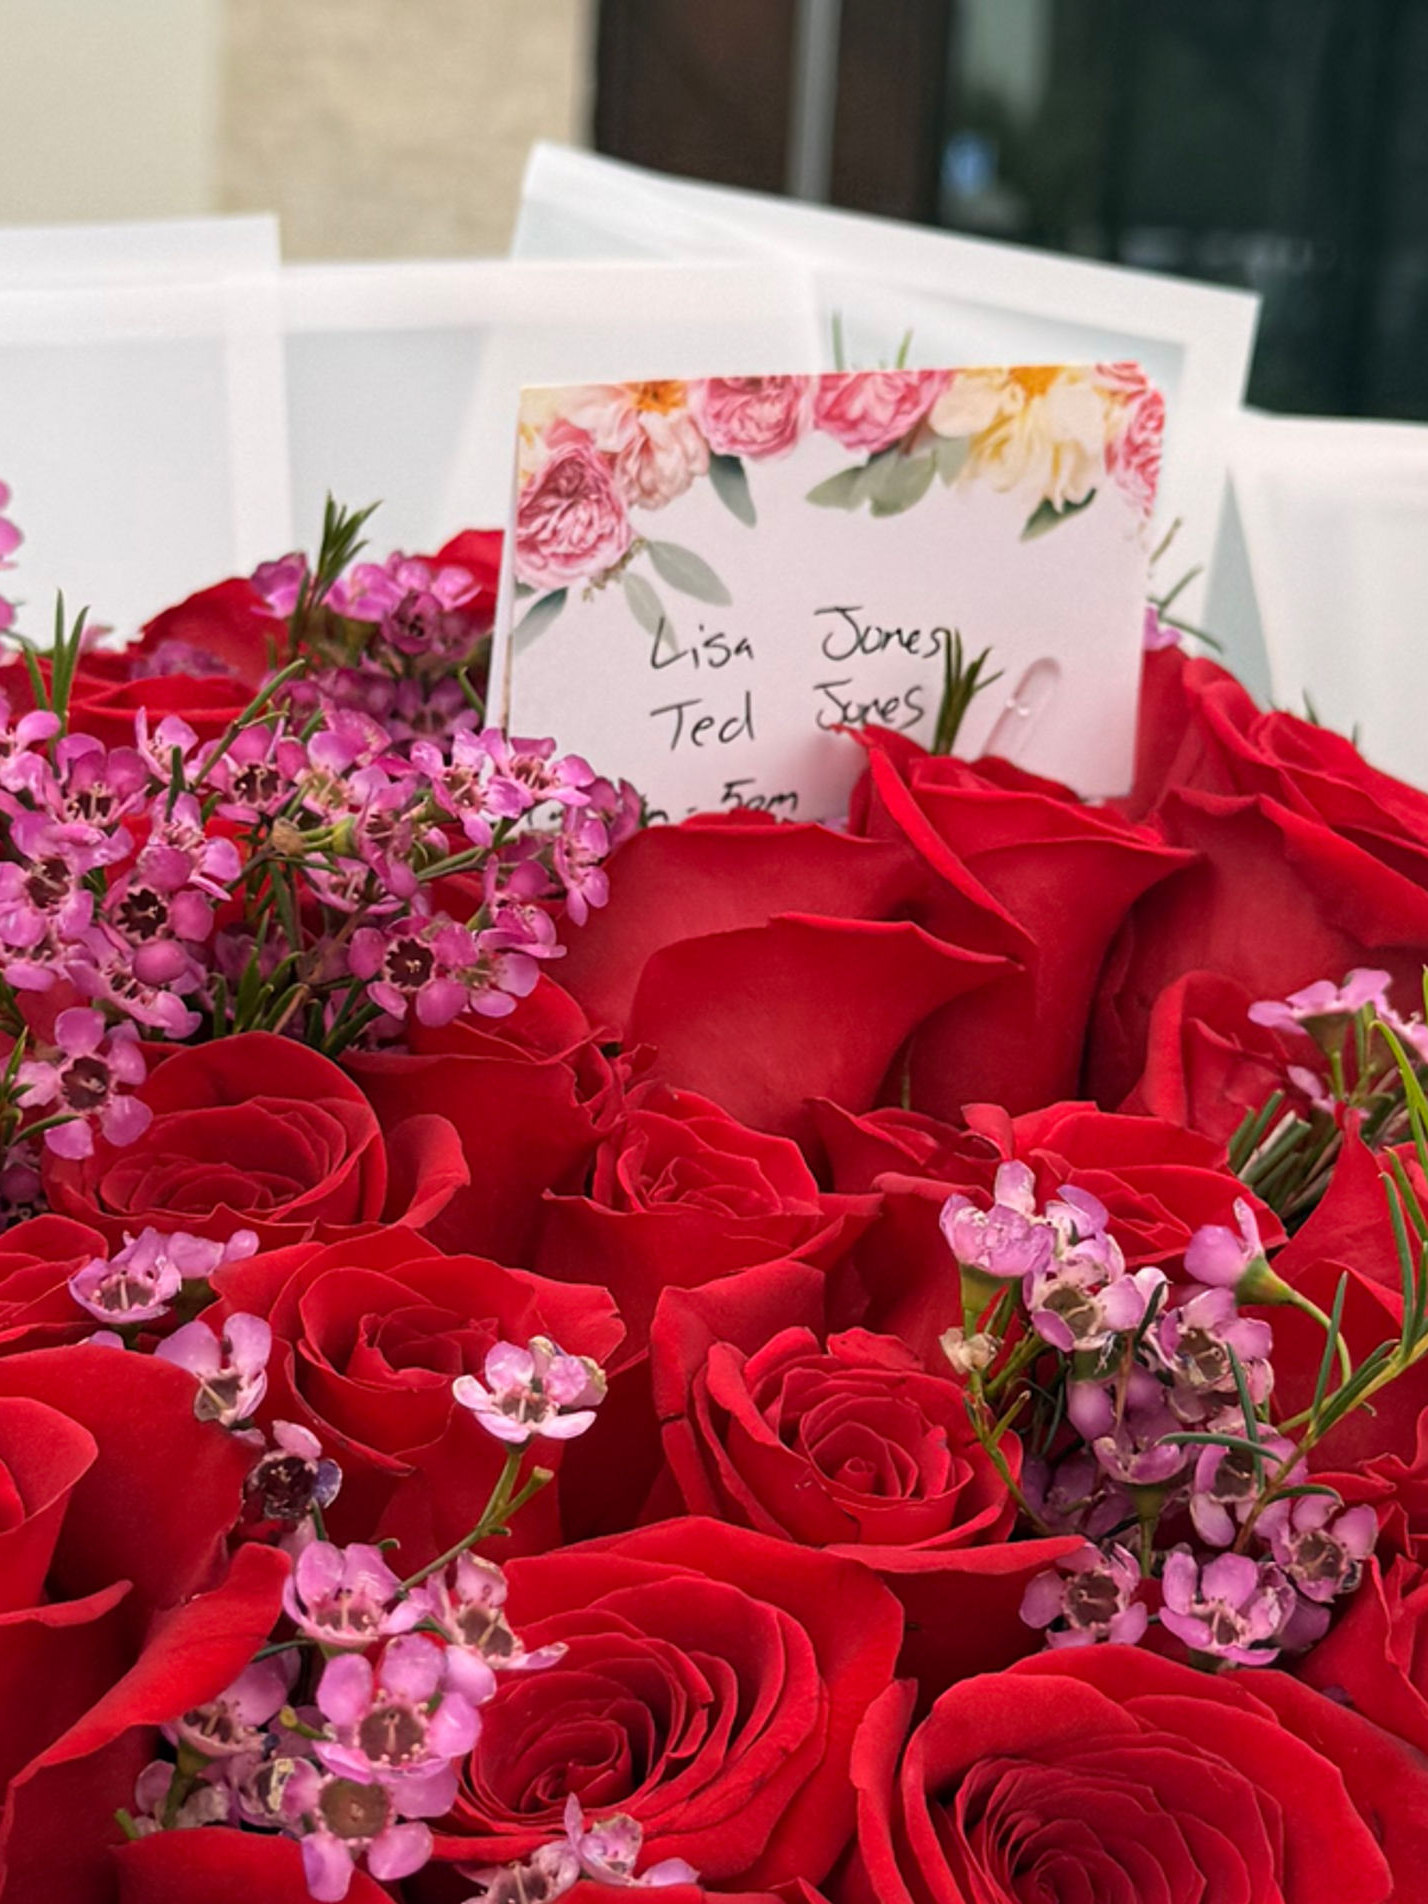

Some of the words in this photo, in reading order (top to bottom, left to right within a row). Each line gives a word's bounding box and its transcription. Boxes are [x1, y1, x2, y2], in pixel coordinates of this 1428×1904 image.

[650, 616, 755, 669] Lisa
[813, 605, 948, 661] Jones
[649, 690, 755, 752] Ted
[813, 677, 925, 731] Jones
